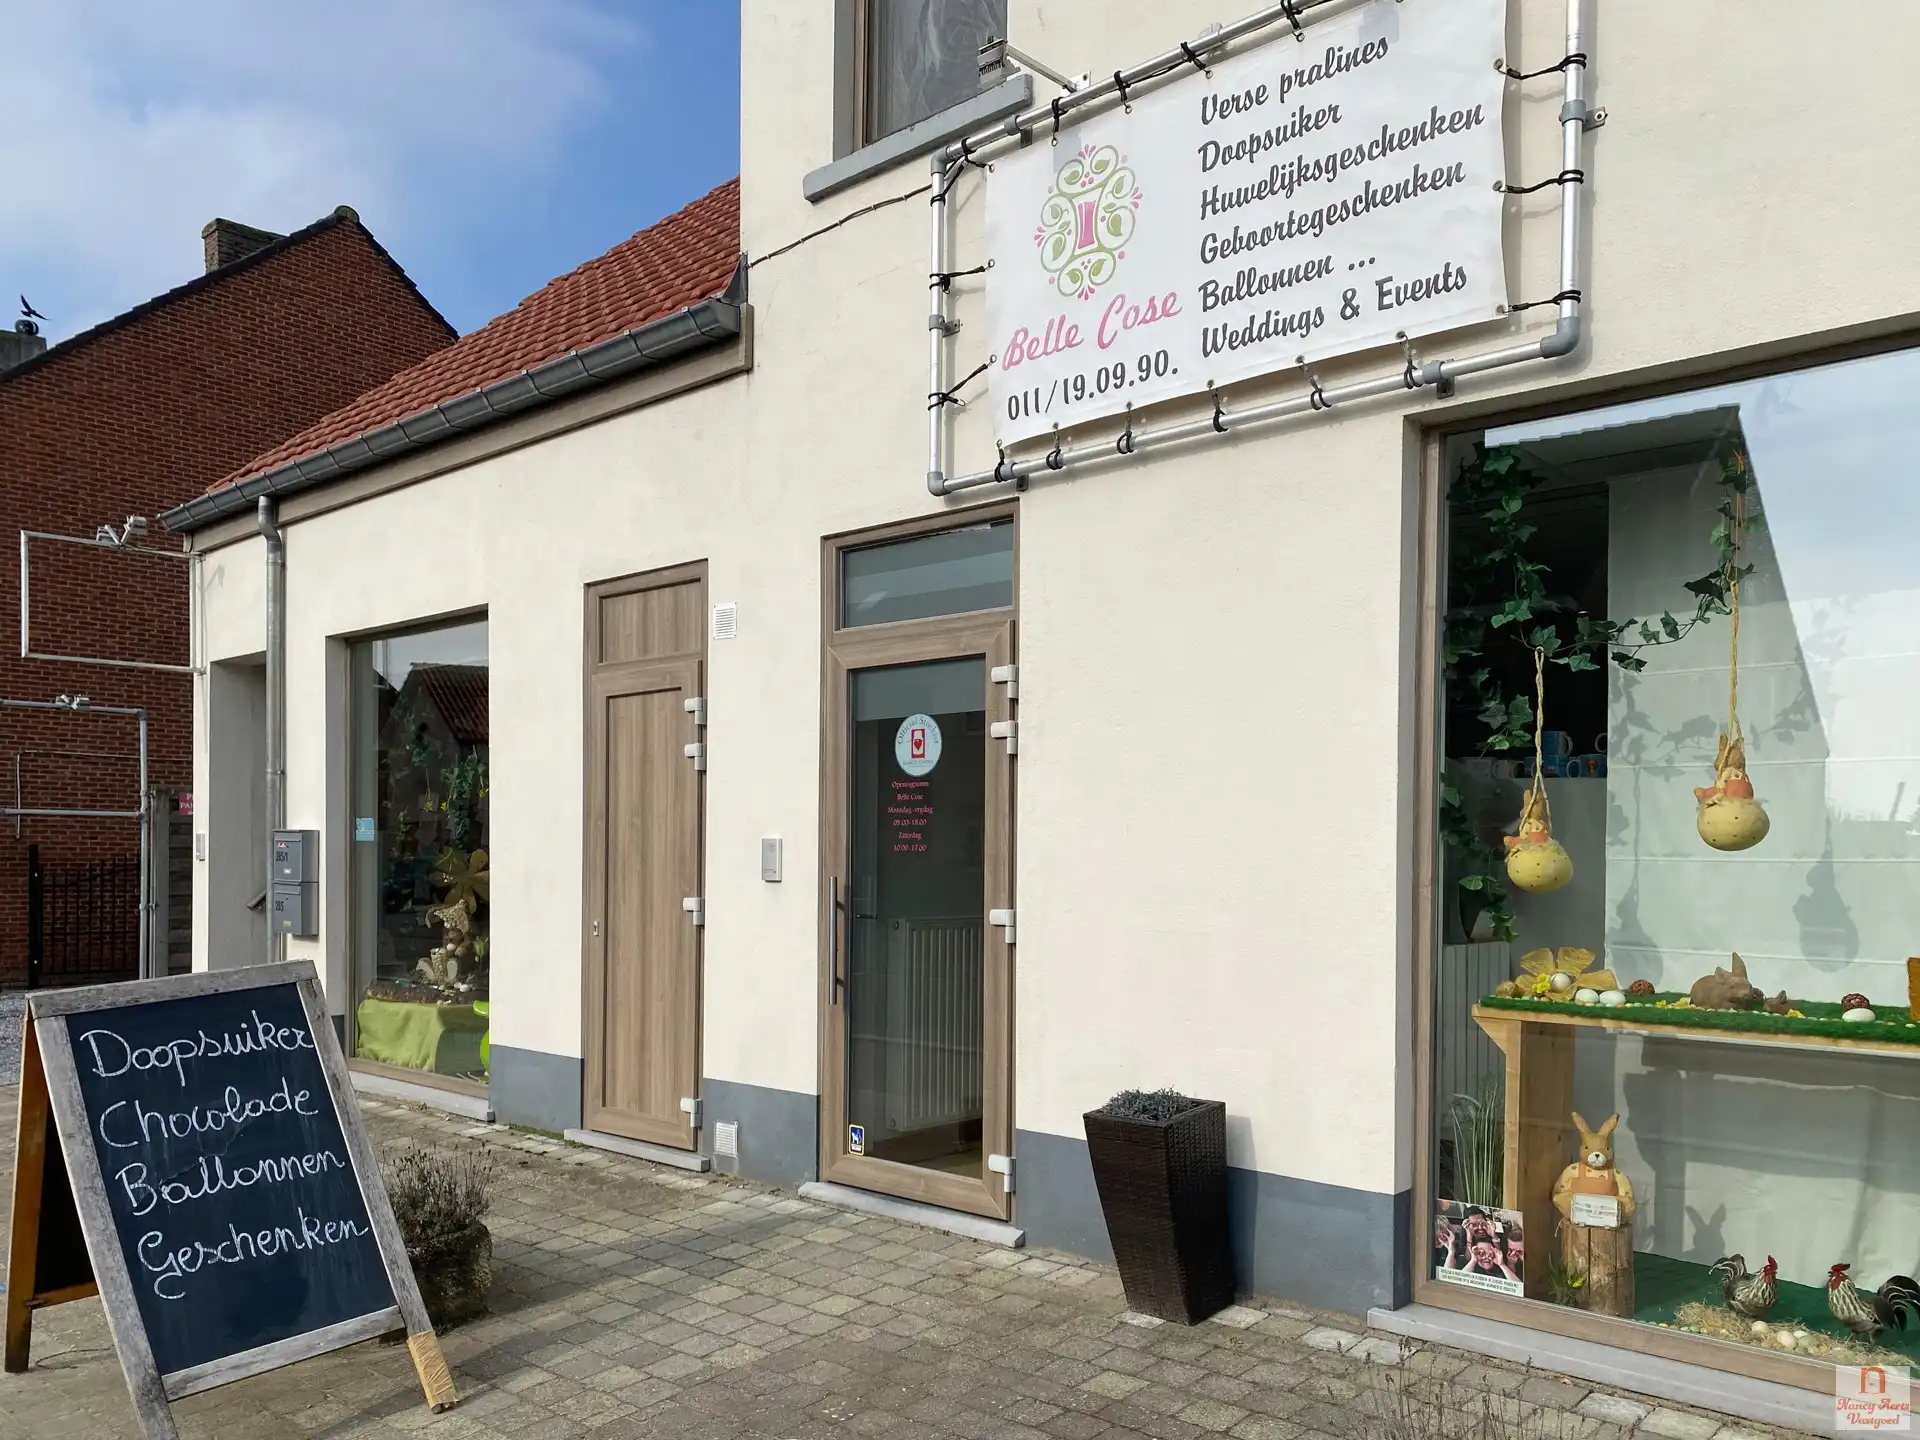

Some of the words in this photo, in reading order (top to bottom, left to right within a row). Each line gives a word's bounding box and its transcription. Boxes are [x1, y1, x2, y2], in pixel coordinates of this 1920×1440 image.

[1200, 85, 1269, 126] Verse
[1279, 36, 1389, 104] pralines
[1198, 102, 1342, 173] Doopsuiker
[1200, 103, 1485, 221] Huwelijksgeschenken
[1199, 161, 1467, 264] Geboortegeschenken
[1198, 251, 1335, 312] Ballonnen
[1201, 304, 1325, 358] Weddings
[1339, 288, 1361, 322] &
[1376, 262, 1468, 313] Events
[1001, 317, 1085, 371] Belle
[1097, 290, 1183, 350] Cose
[1007, 349, 1179, 421] 011/19.09.90.
[80, 1009, 315, 1087] Doopsuiker
[99, 1076, 319, 1148] Chocolade
[115, 1146, 346, 1217] Ballonnen
[137, 1206, 370, 1300] Geschenken
